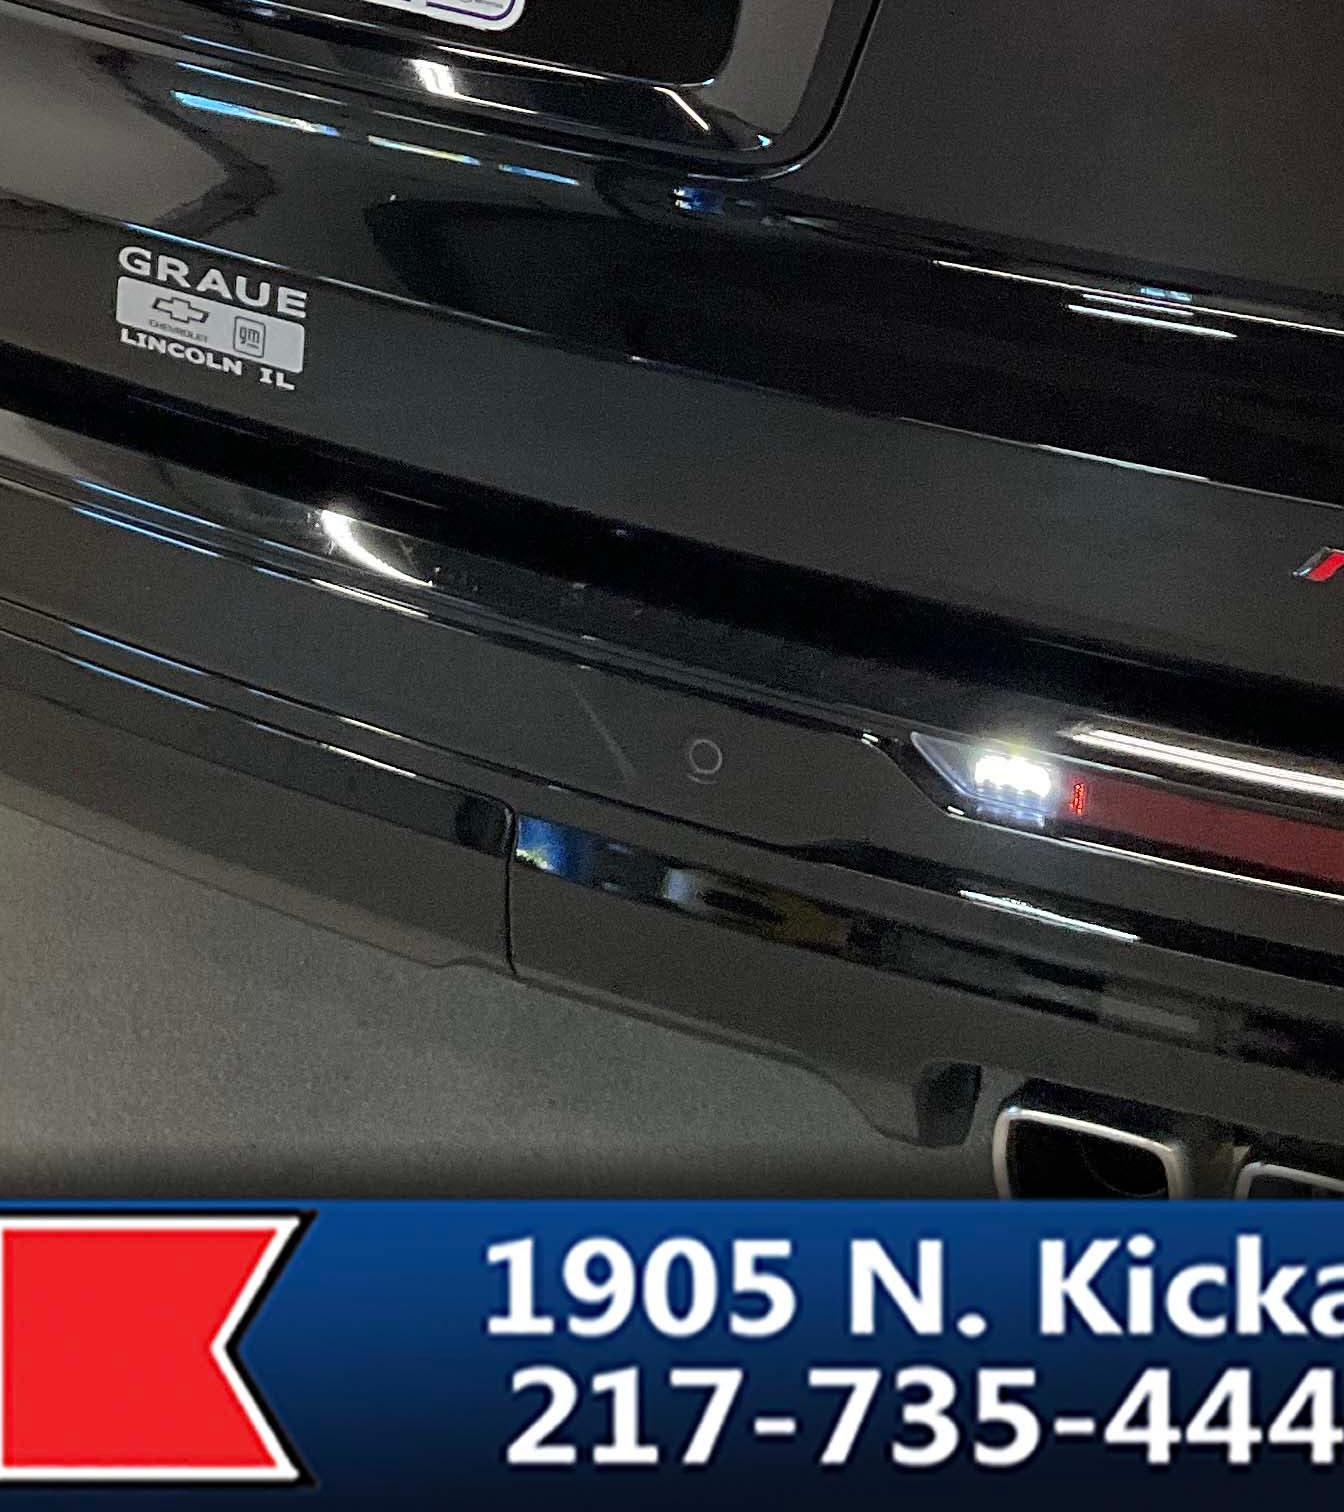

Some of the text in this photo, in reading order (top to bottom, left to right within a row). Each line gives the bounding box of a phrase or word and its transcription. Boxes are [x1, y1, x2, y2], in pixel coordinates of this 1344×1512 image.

[118, 246, 308, 319] GRAUE
[120, 328, 296, 391] LINCOLN IL
